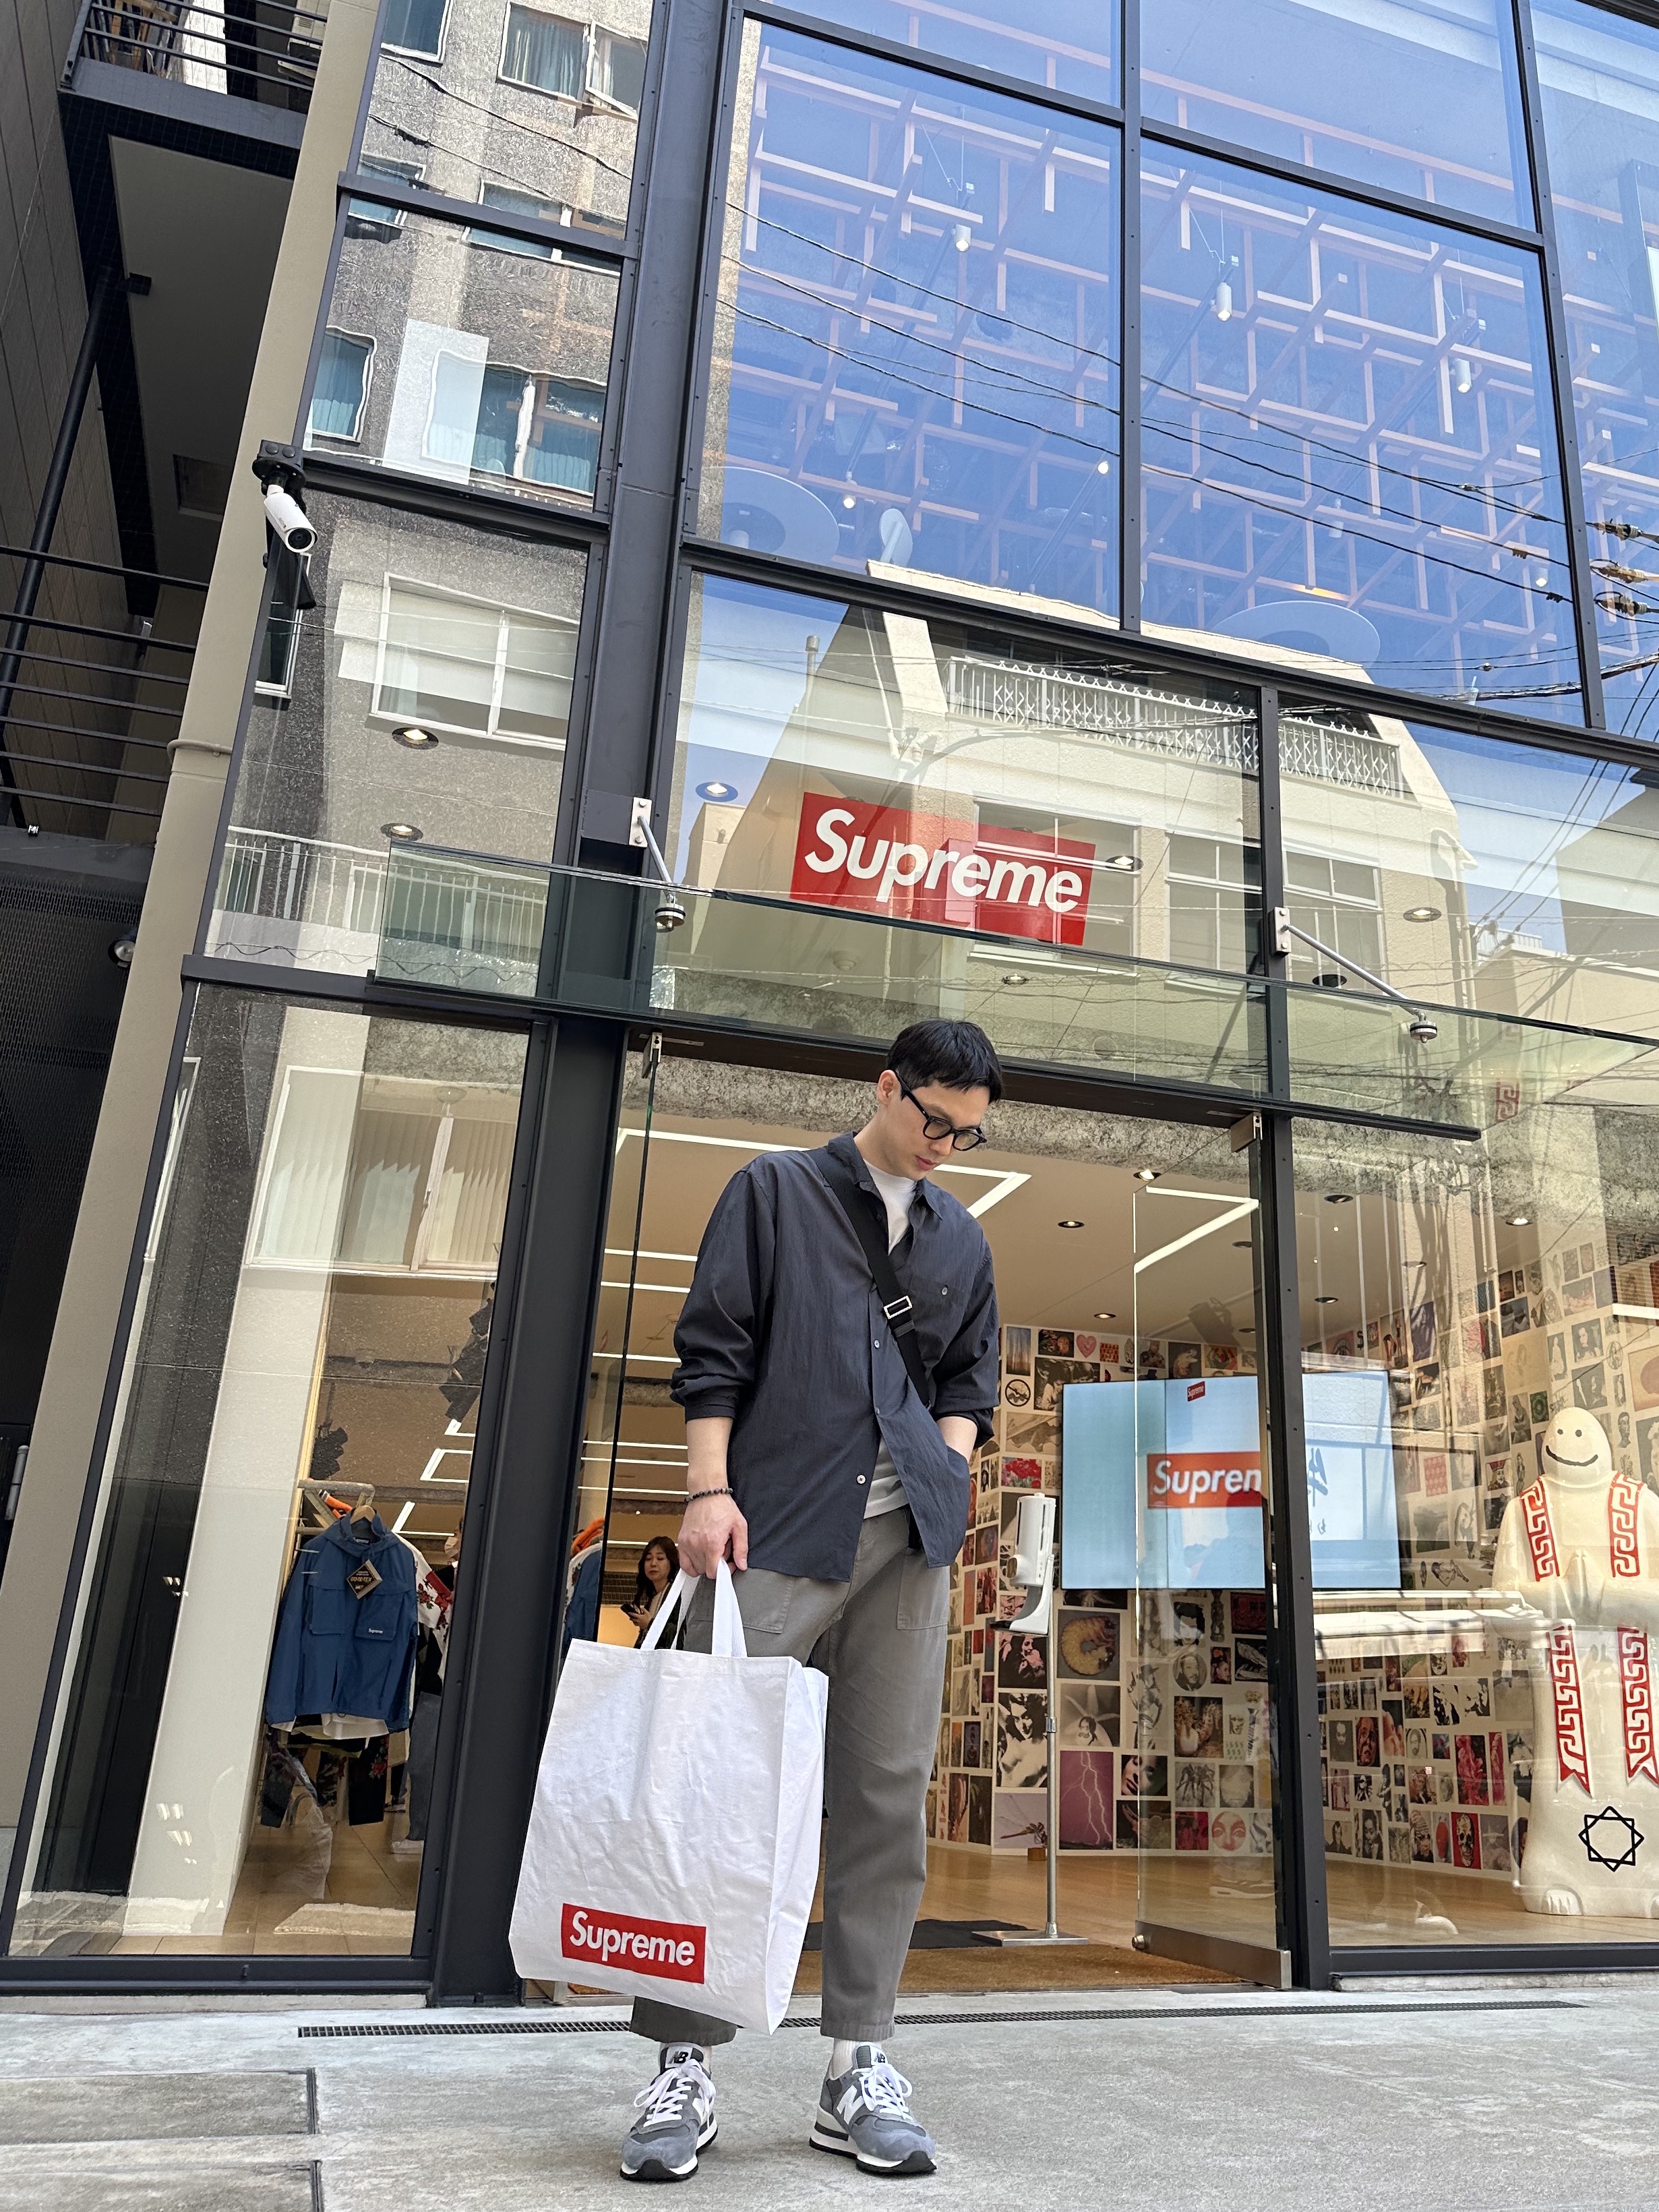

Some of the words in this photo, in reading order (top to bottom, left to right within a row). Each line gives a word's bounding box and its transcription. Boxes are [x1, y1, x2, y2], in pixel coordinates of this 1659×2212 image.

[805, 808, 1083, 913] Supreme
[570, 1910, 695, 1966] Supreme
[837, 2085, 865, 2125] N
